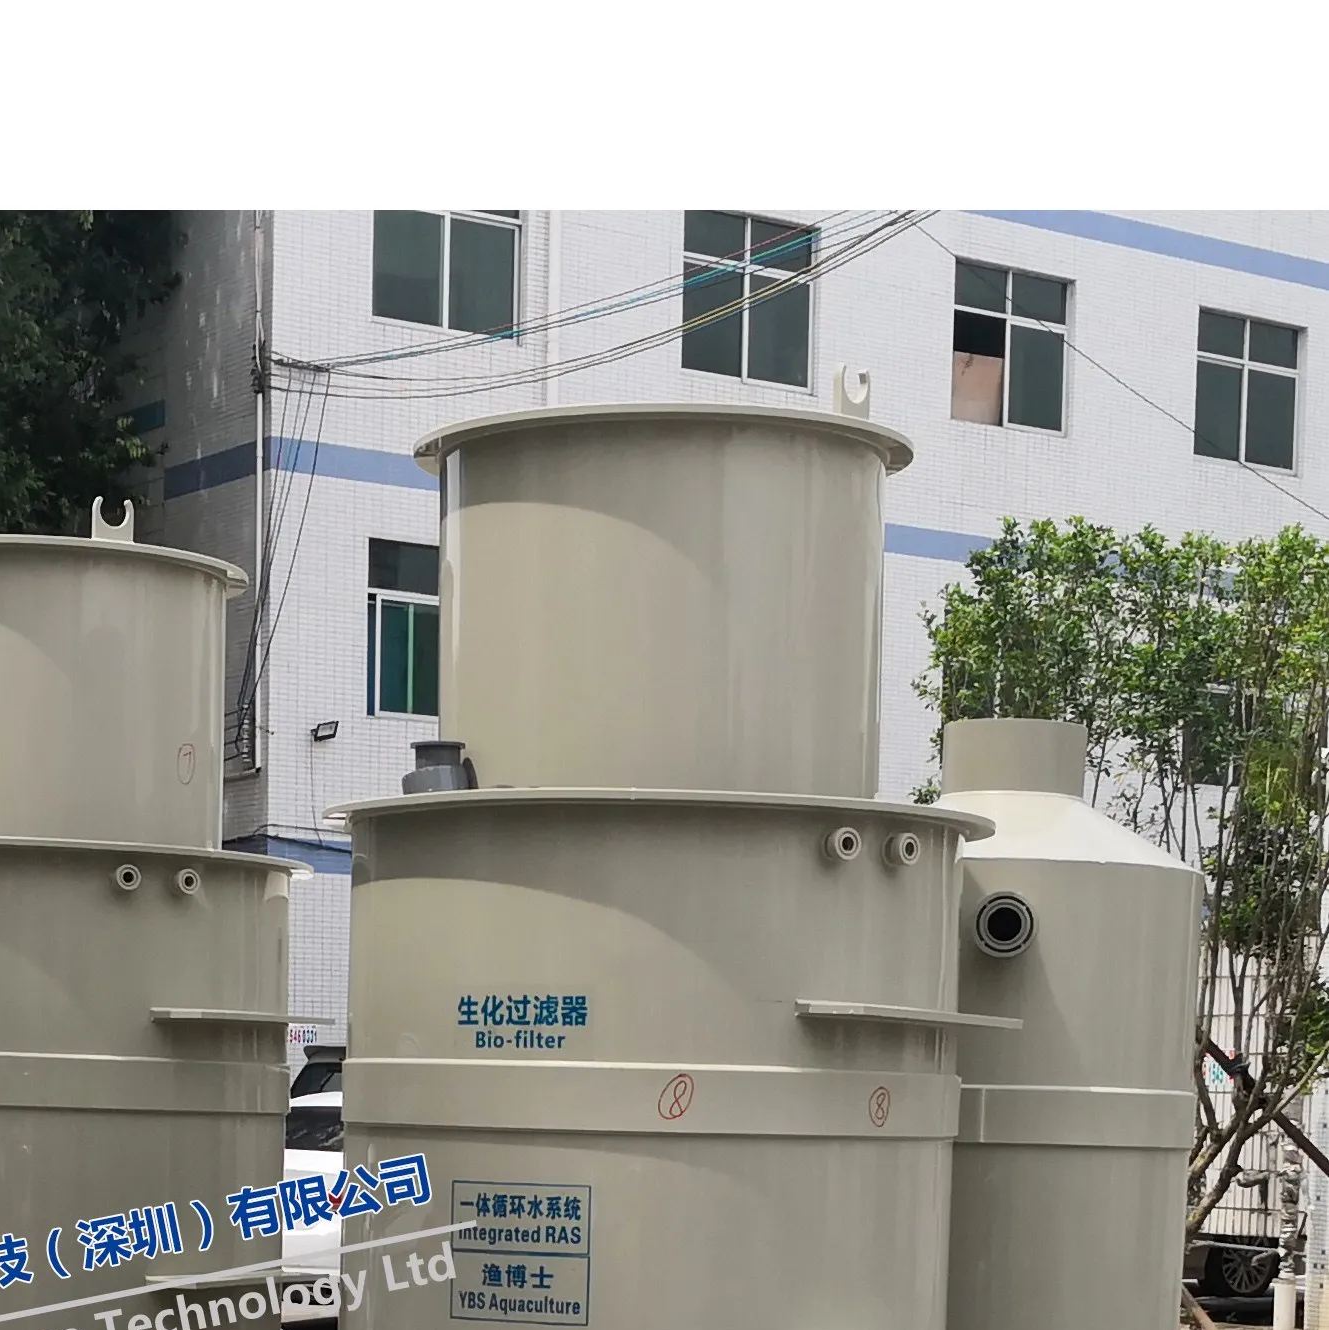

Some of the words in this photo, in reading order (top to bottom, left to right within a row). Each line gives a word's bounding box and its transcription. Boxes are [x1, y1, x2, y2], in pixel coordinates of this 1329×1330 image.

[458, 995, 588, 1026] 生化过滤器
[475, 1031, 566, 1050] Bio-filter
[460, 1193, 581, 1221] 一体循环水系统
[458, 1222, 541, 1245] Integrated
[545, 1225, 581, 1244] RAS
[482, 1264, 554, 1289] 渔博士
[458, 1292, 487, 1311] YBS
[490, 1295, 581, 1316] Aquaculture
